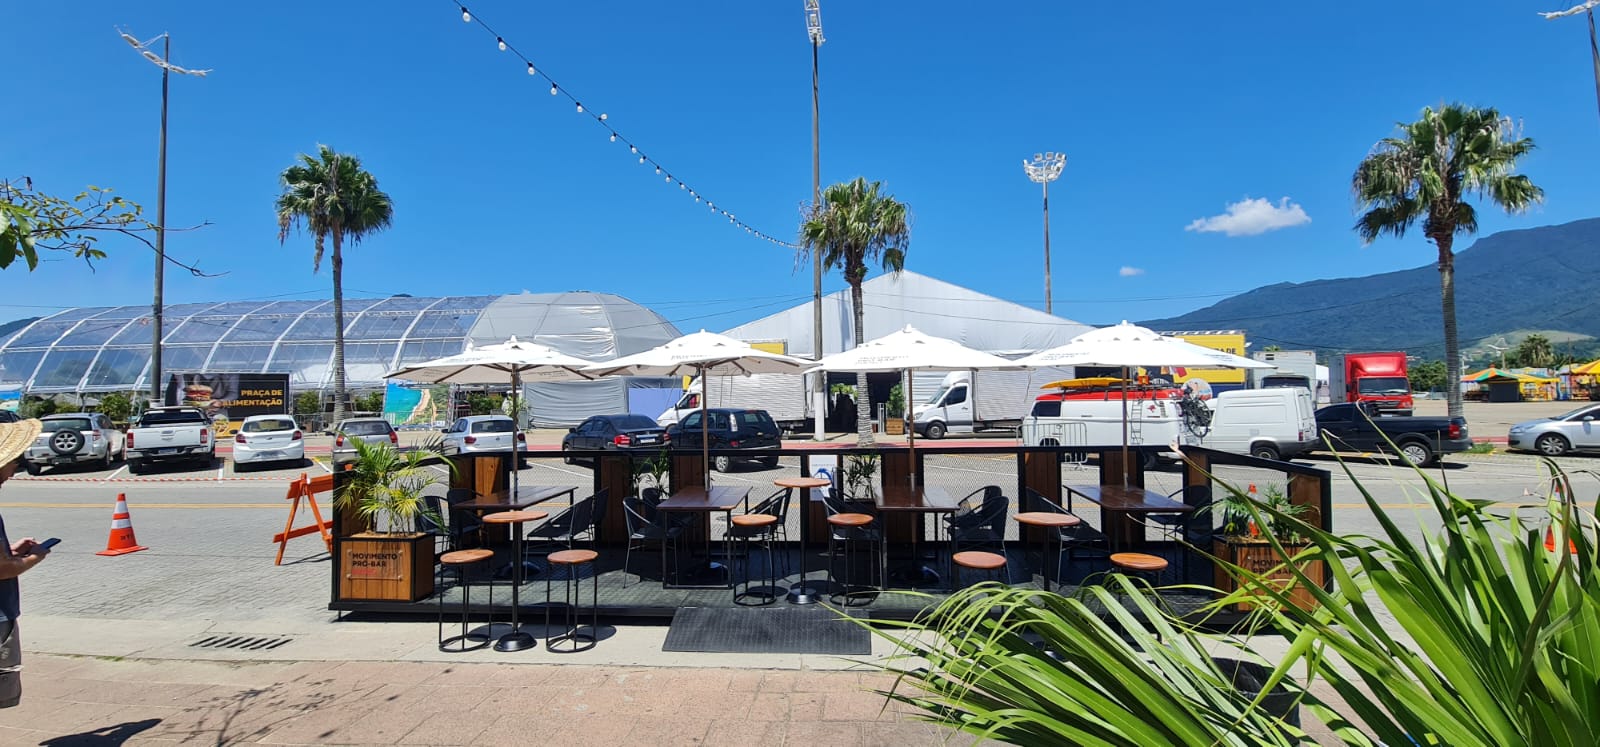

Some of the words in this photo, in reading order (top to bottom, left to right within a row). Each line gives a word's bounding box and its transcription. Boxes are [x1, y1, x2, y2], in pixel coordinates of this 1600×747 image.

[241, 389, 270, 397] PRAÇA
[223, 398, 283, 407] ALIMENTAÇÃO
[352, 552, 398, 560] MOVIMENTO
